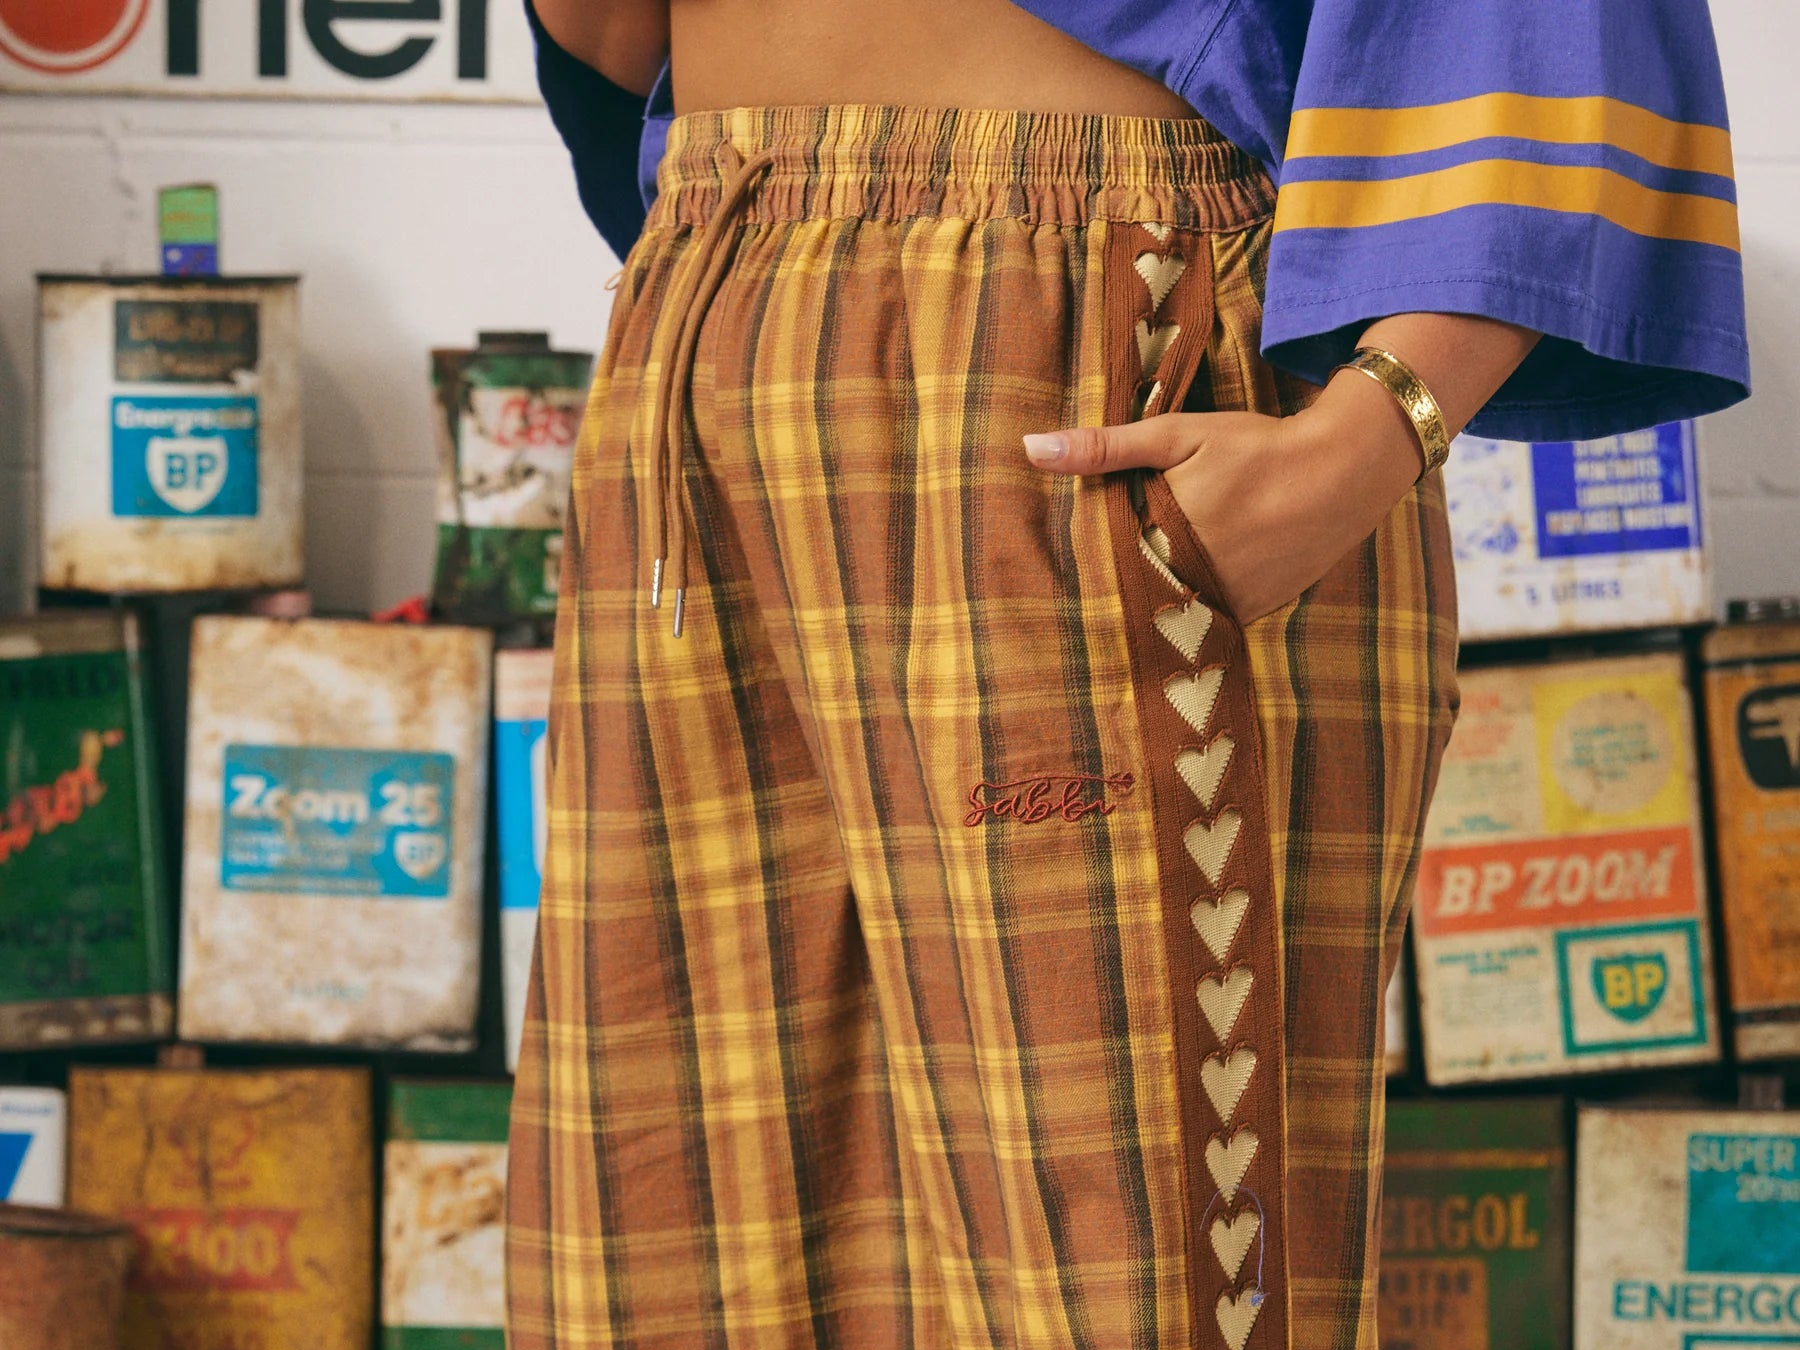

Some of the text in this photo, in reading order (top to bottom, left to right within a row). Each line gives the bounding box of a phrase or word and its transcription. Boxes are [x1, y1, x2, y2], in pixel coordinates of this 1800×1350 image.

[164, 453, 217, 490] BP
[230, 775, 369, 824] Zoom
[379, 781, 441, 827] 25
[1435, 844, 1679, 917] BP ZOOM
[1602, 962, 1665, 1009] BP
[1688, 1137, 1796, 1173] SUPER
